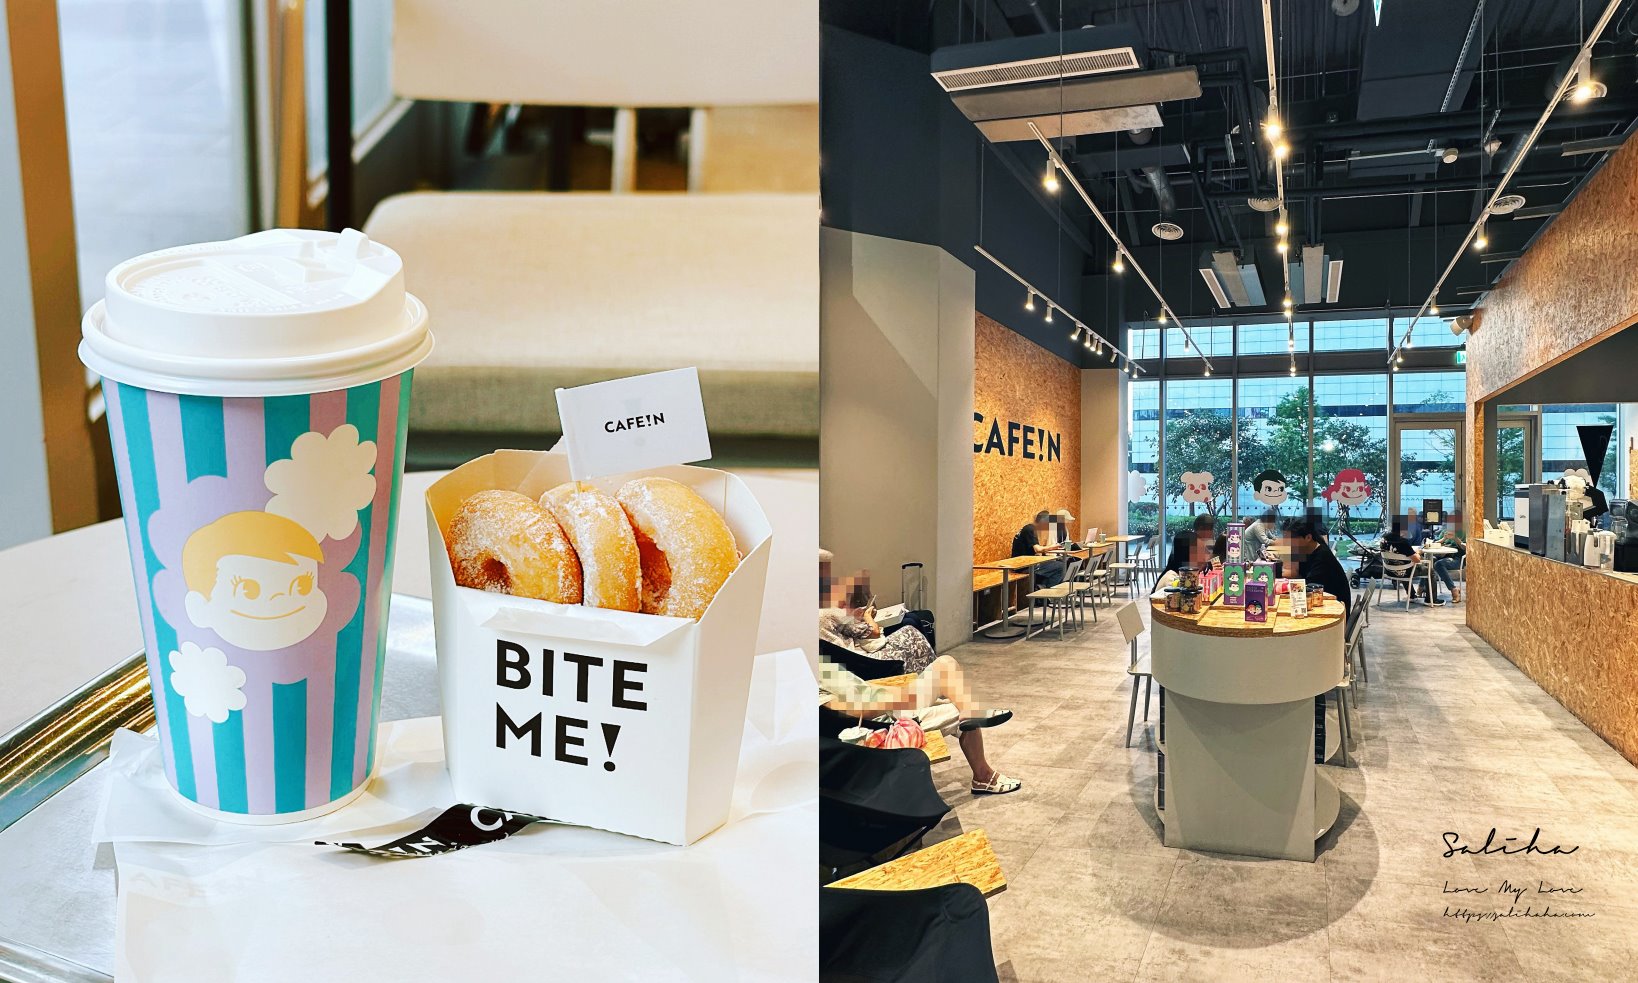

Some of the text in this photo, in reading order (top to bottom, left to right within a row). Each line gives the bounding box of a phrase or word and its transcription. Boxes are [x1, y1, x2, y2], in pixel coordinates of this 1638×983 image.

[604, 412, 665, 433] CAFE!N
[496, 638, 648, 711] BITE
[496, 701, 622, 772] ME!
